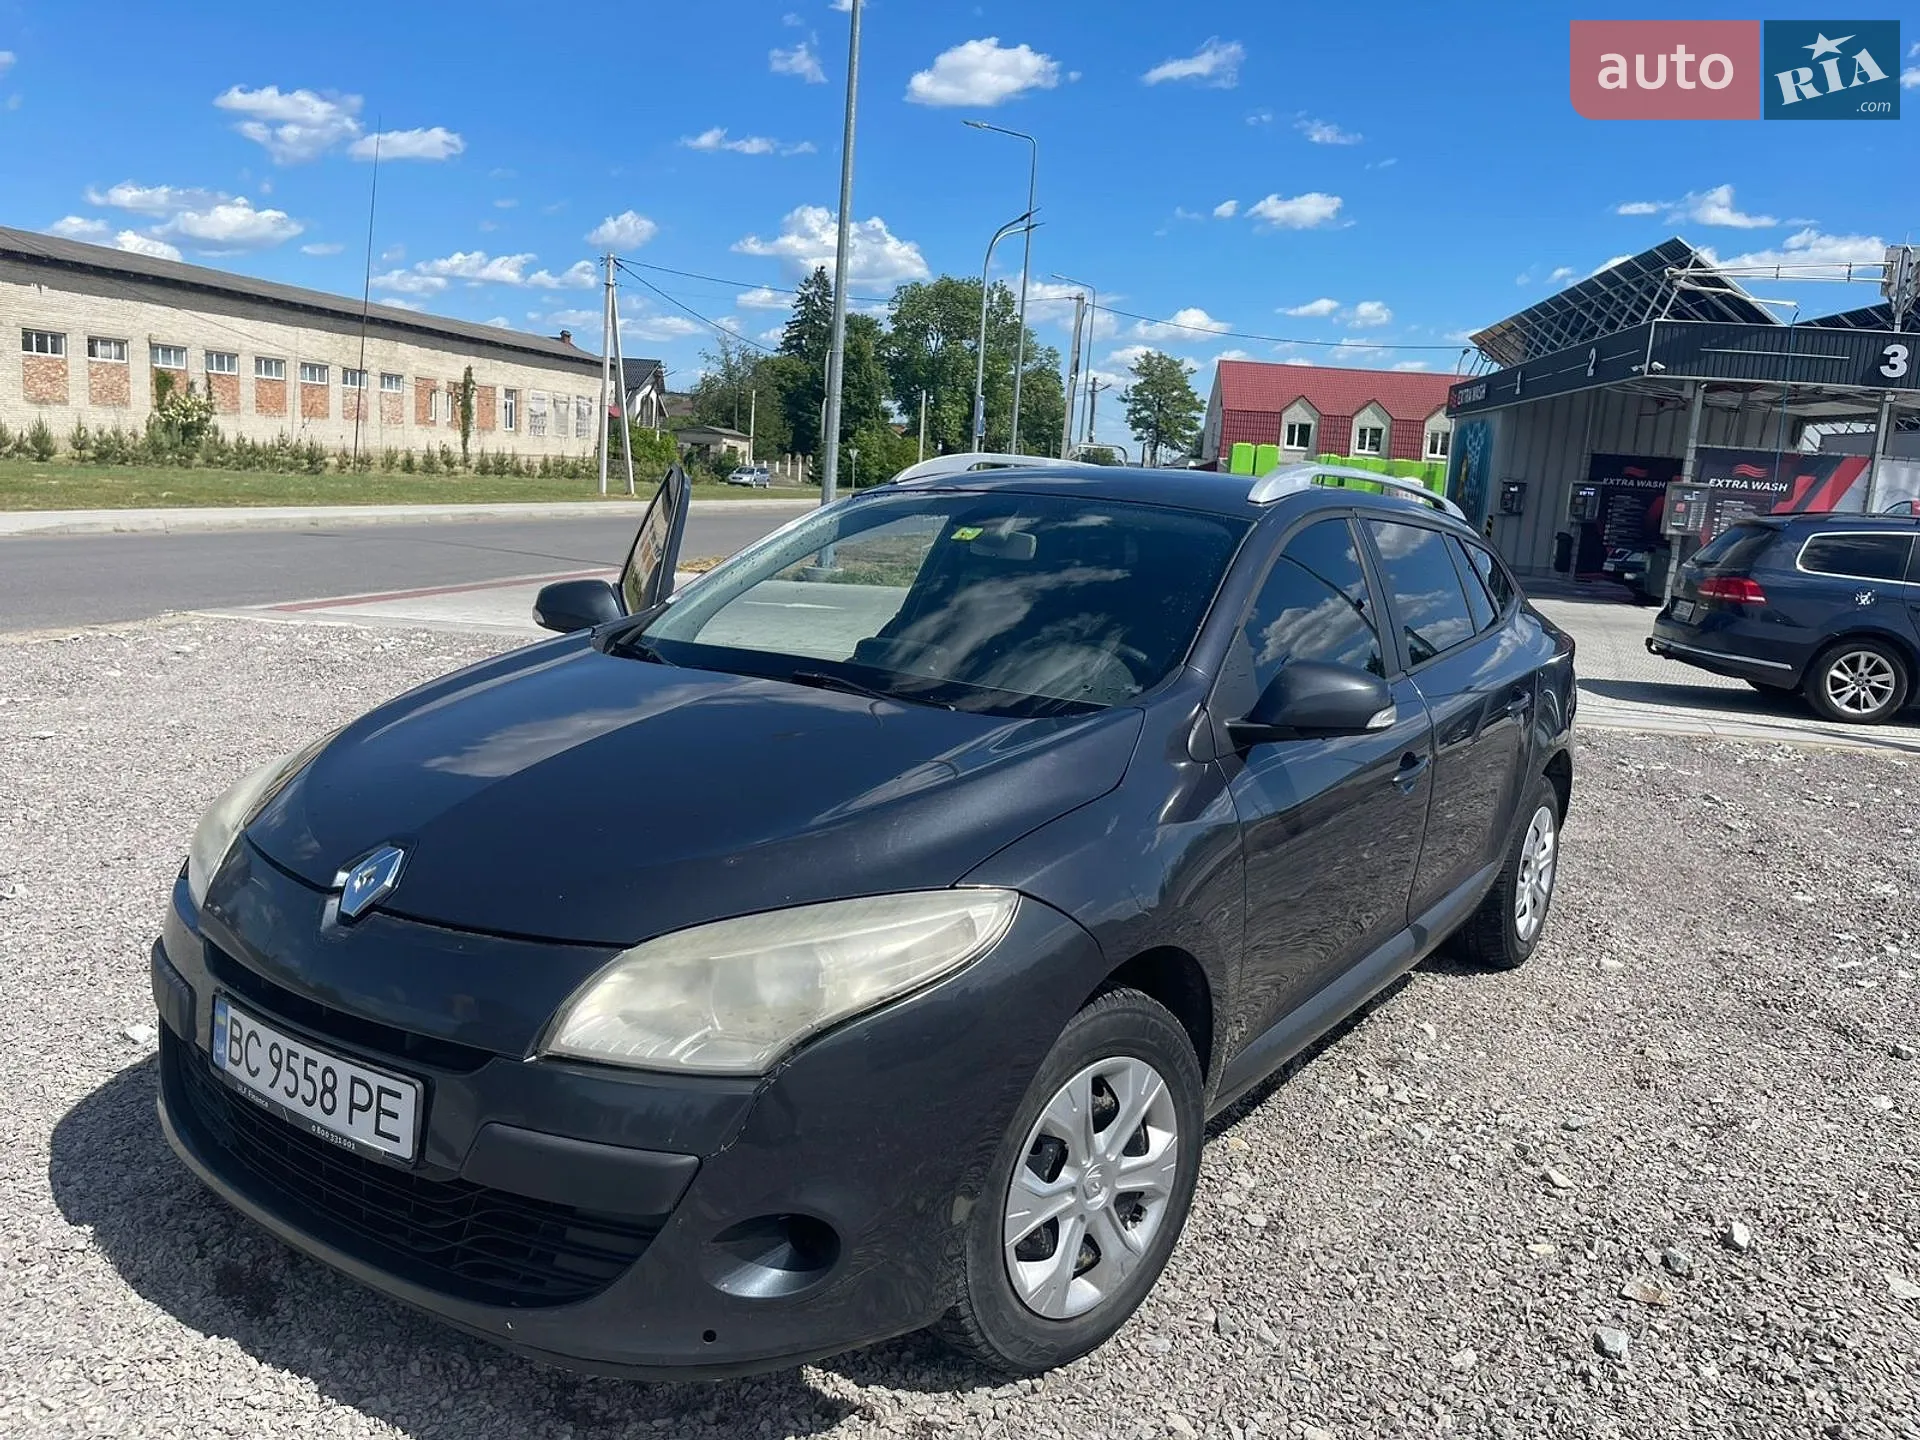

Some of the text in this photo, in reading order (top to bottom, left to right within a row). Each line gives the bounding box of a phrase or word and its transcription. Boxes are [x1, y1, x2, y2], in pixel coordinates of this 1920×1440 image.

[1587, 348, 1596, 377] 2
[1879, 344, 1908, 378] 3
[1515, 371, 1521, 395] 1
[1603, 478, 1666, 488] EXTRA WASH
[1709, 478, 1788, 493] EXTRA WASH
[228, 1016, 402, 1143] BC 9558 PE
